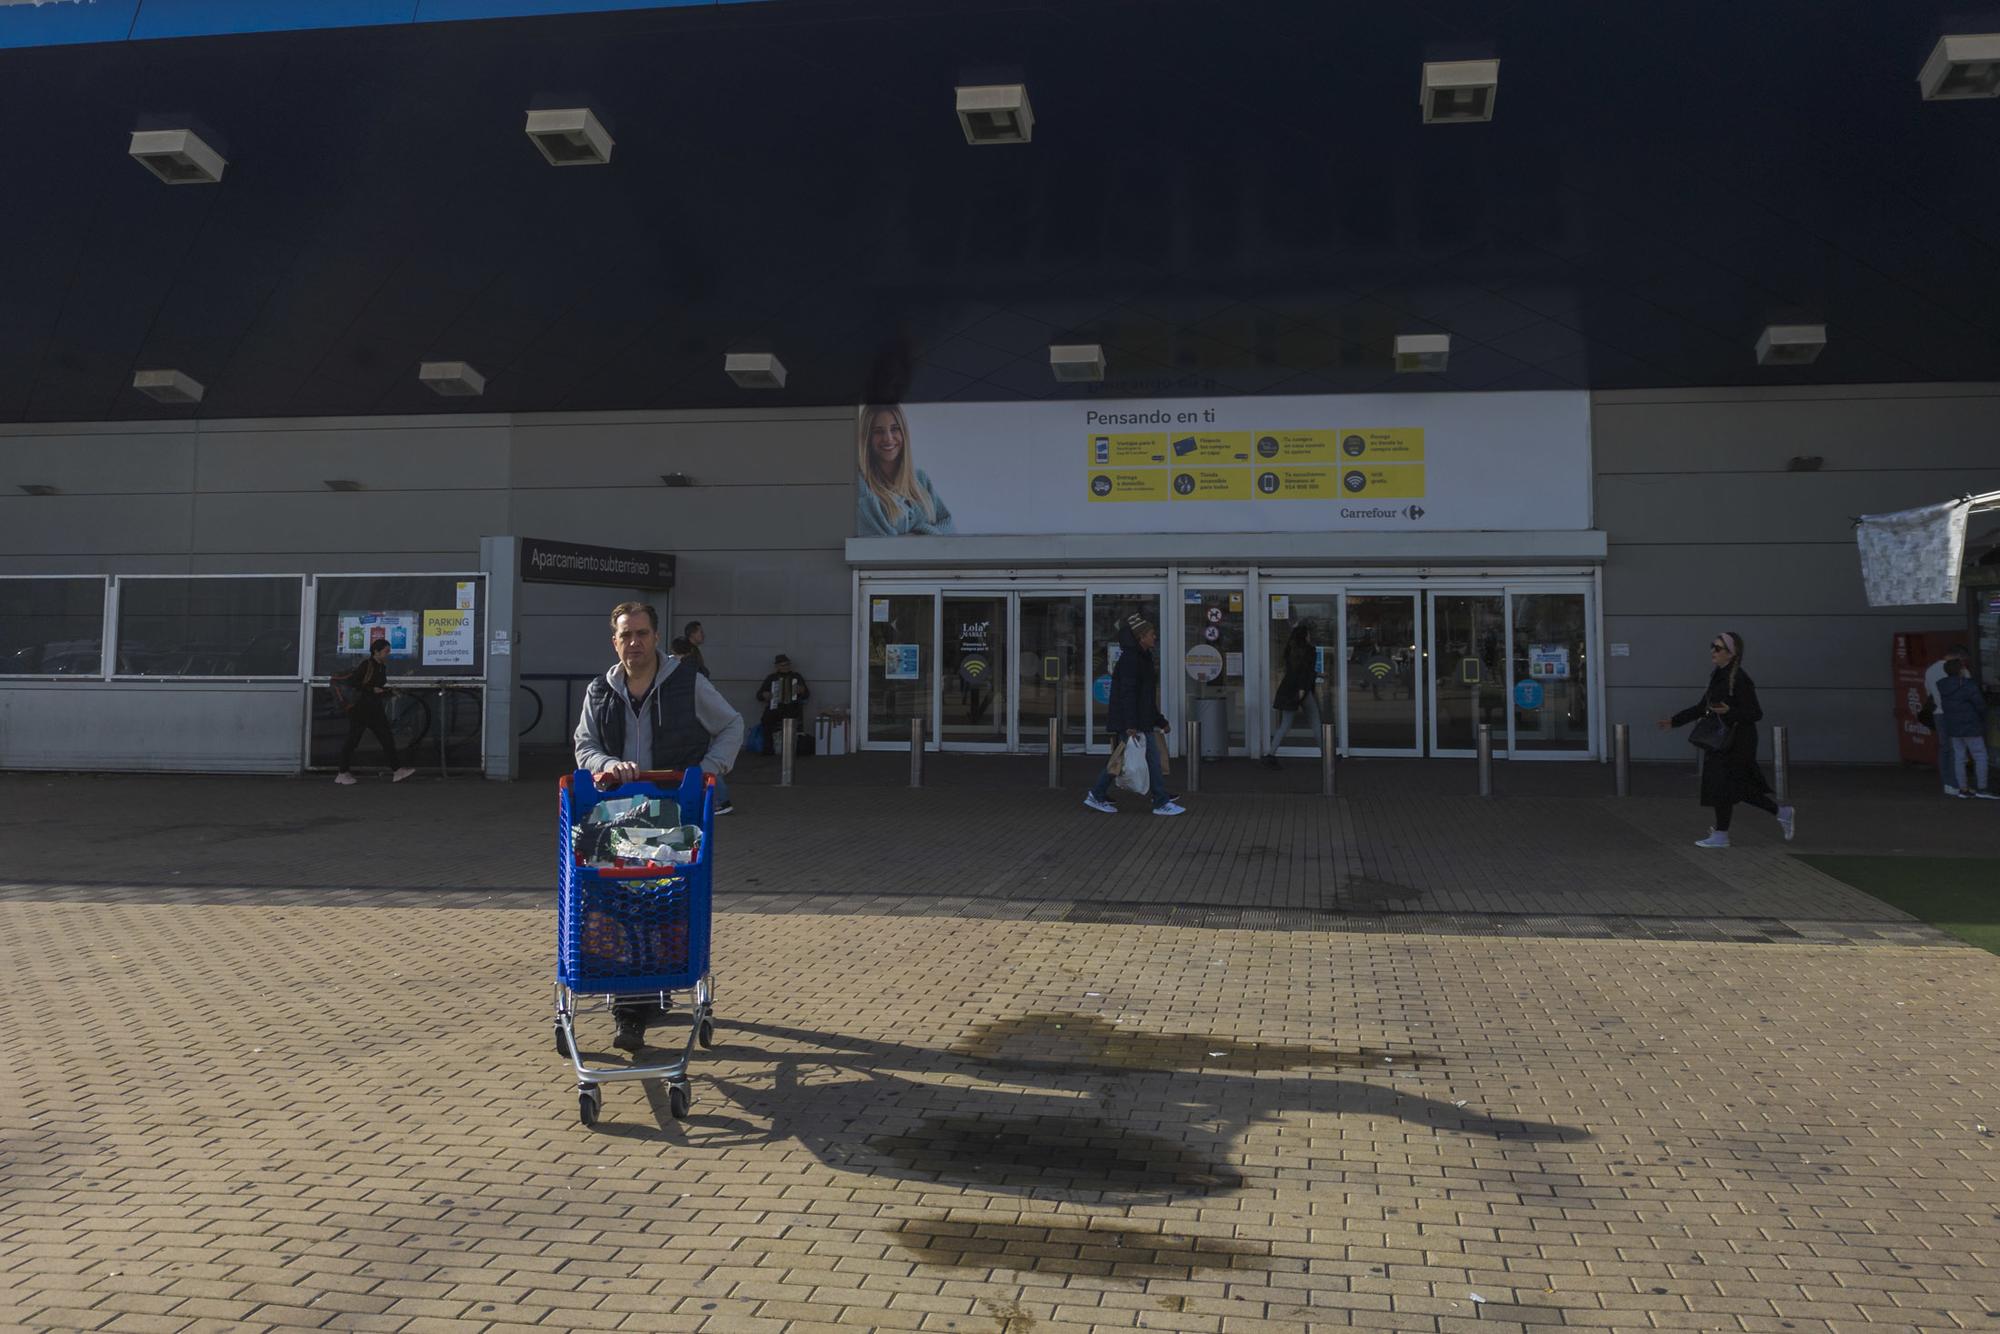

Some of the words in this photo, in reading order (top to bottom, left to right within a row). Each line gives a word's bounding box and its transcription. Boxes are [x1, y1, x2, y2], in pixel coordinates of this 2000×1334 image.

[1087, 409, 1171, 425] Pensando
[1177, 412, 1197, 423] en
[1203, 408, 1215, 423] ti
[1340, 507, 1397, 519] Carrefour
[531, 548, 599, 571] Aparcamiento
[600, 554, 649, 575] subterráneo
[428, 617, 470, 626] PARKING
[435, 627, 442, 636] 3
[443, 628, 461, 636] horas
[962, 622, 984, 632] Lola
[439, 639, 458, 647] gratis
